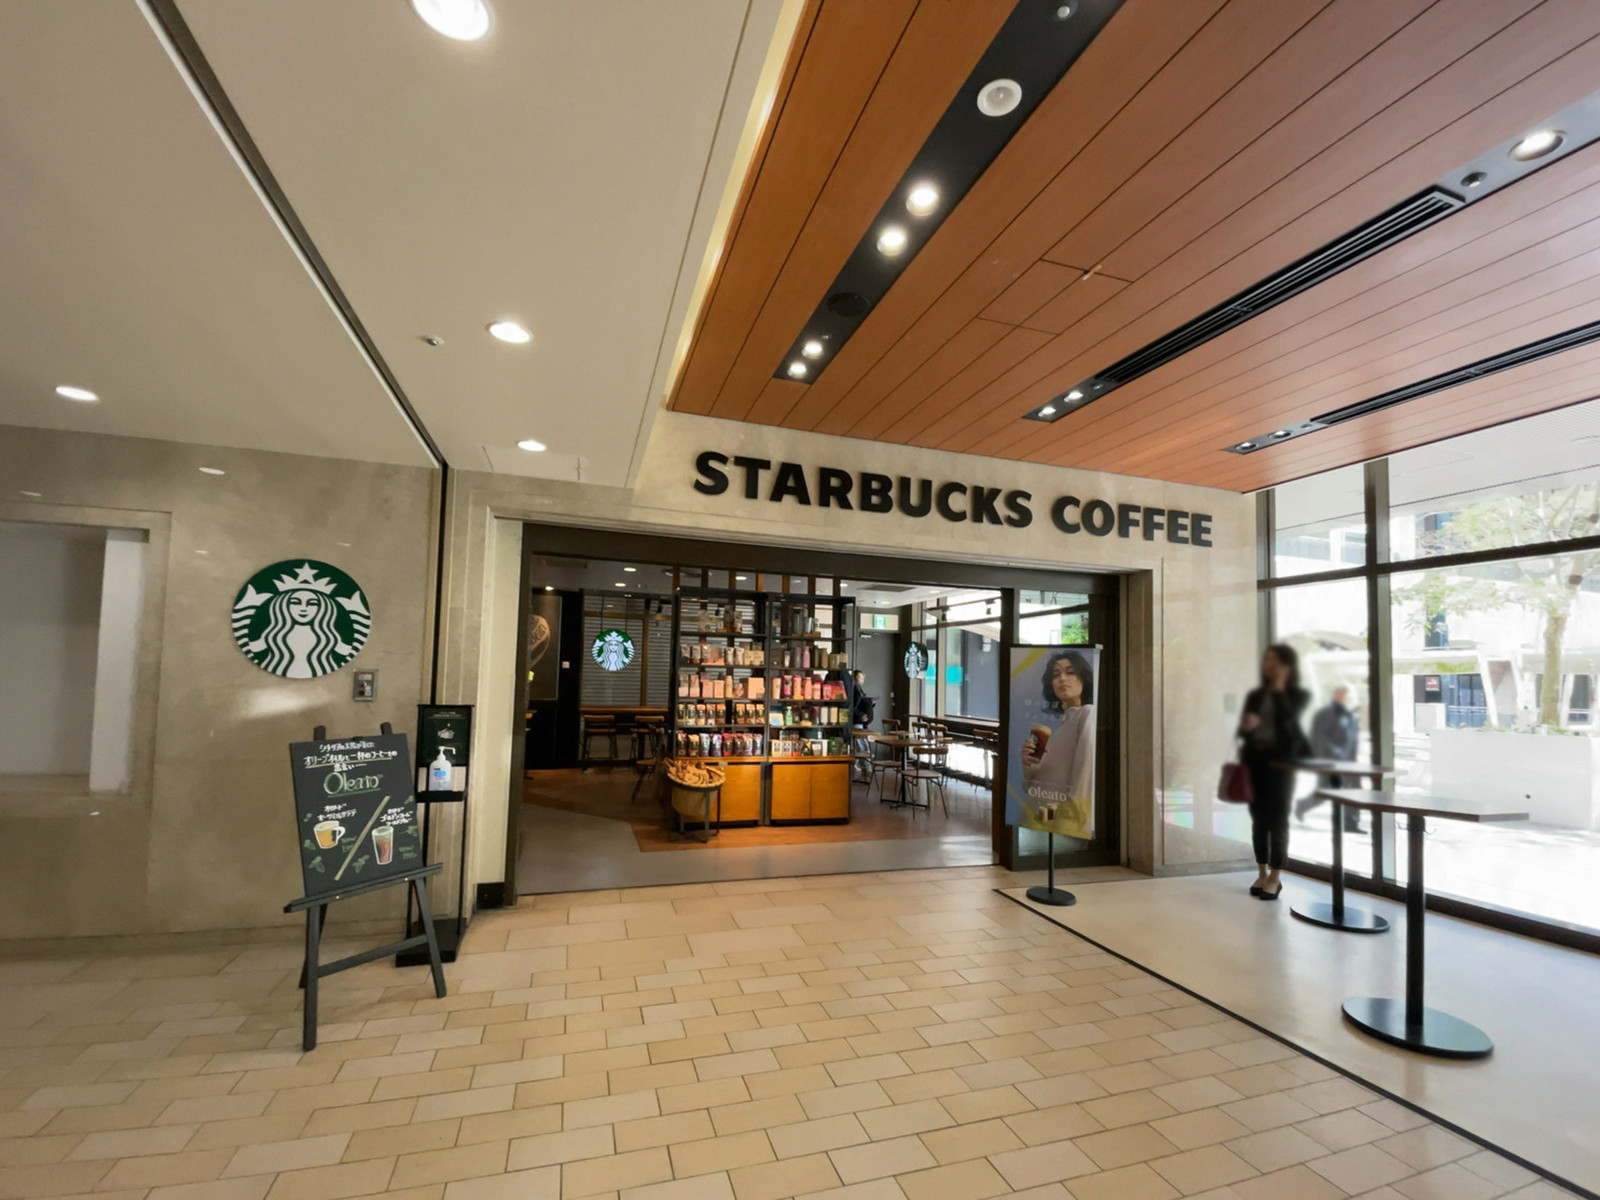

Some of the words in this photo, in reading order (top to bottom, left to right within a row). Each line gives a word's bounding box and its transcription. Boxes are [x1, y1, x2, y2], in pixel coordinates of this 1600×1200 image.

[694, 451, 1033, 528] STARBUCKS
[1051, 495, 1214, 547] COFFEE
[1028, 786, 1067, 802] Oleato
